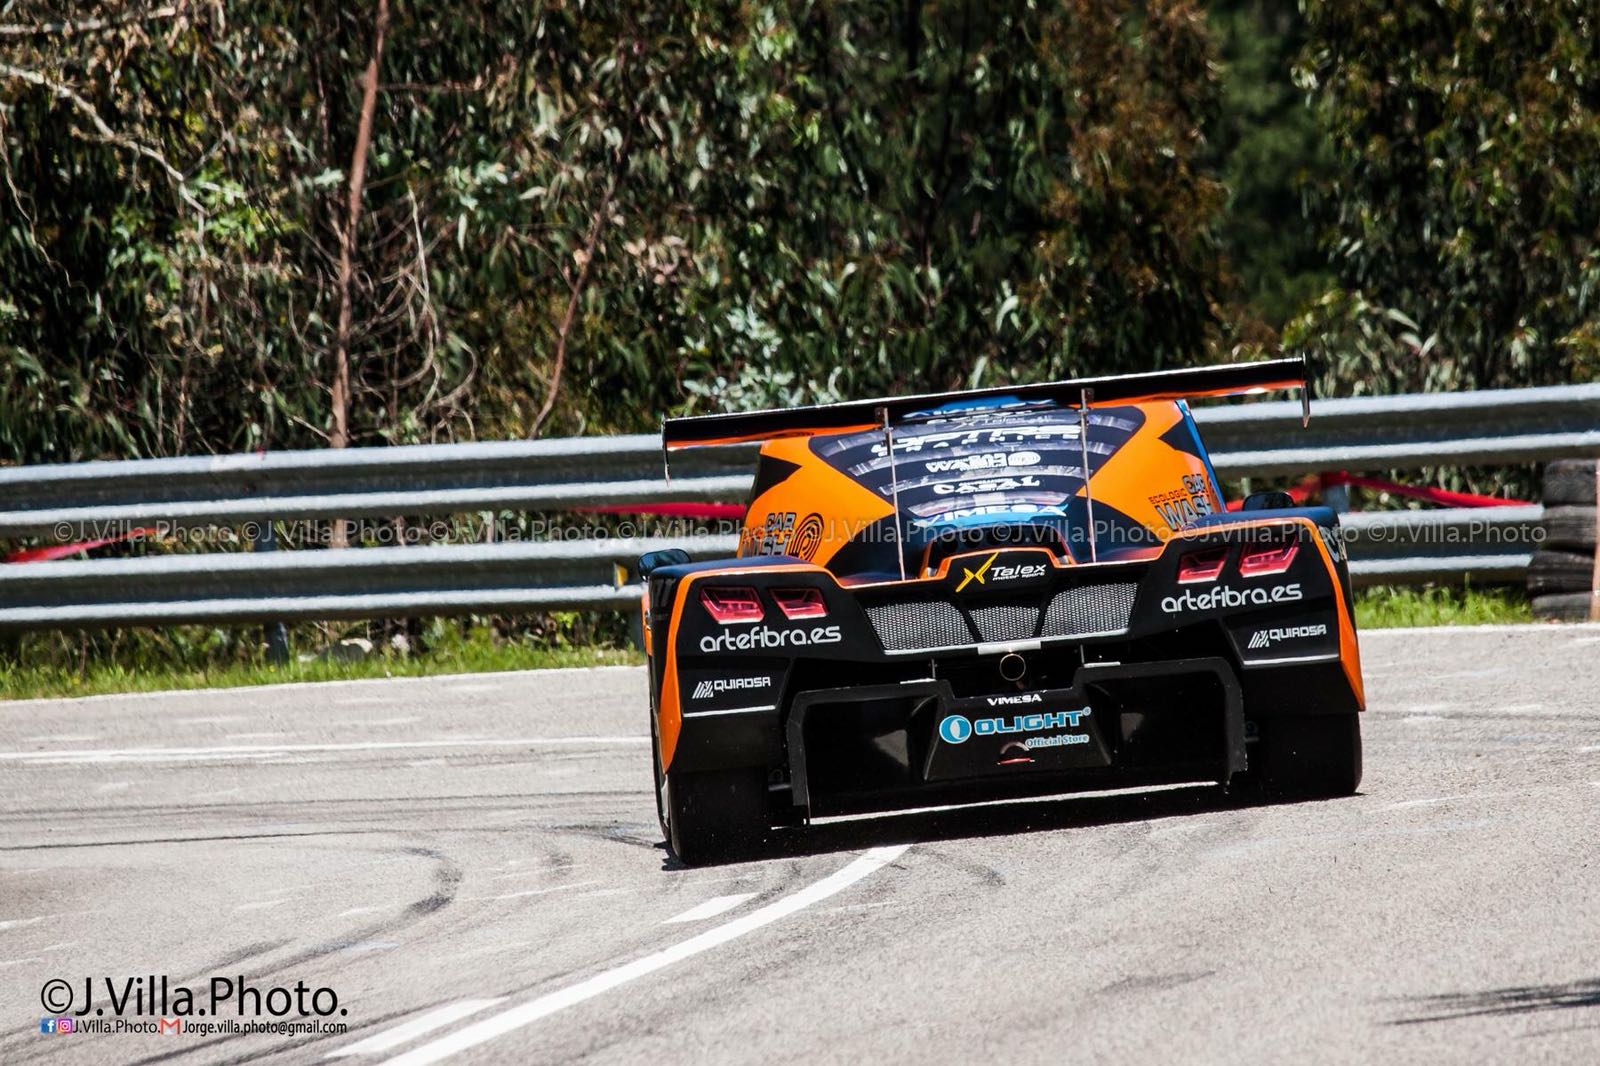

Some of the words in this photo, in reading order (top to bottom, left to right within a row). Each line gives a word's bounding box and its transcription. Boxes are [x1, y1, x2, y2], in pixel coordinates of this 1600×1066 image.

[991, 564, 1047, 578] Talex
[1161, 583, 1303, 613] artefibra.es
[700, 625, 842, 653] artefibra.es
[987, 693, 1042, 706] VIMESA
[1025, 735, 1063, 749] Official
[1062, 734, 1090, 745] Store
